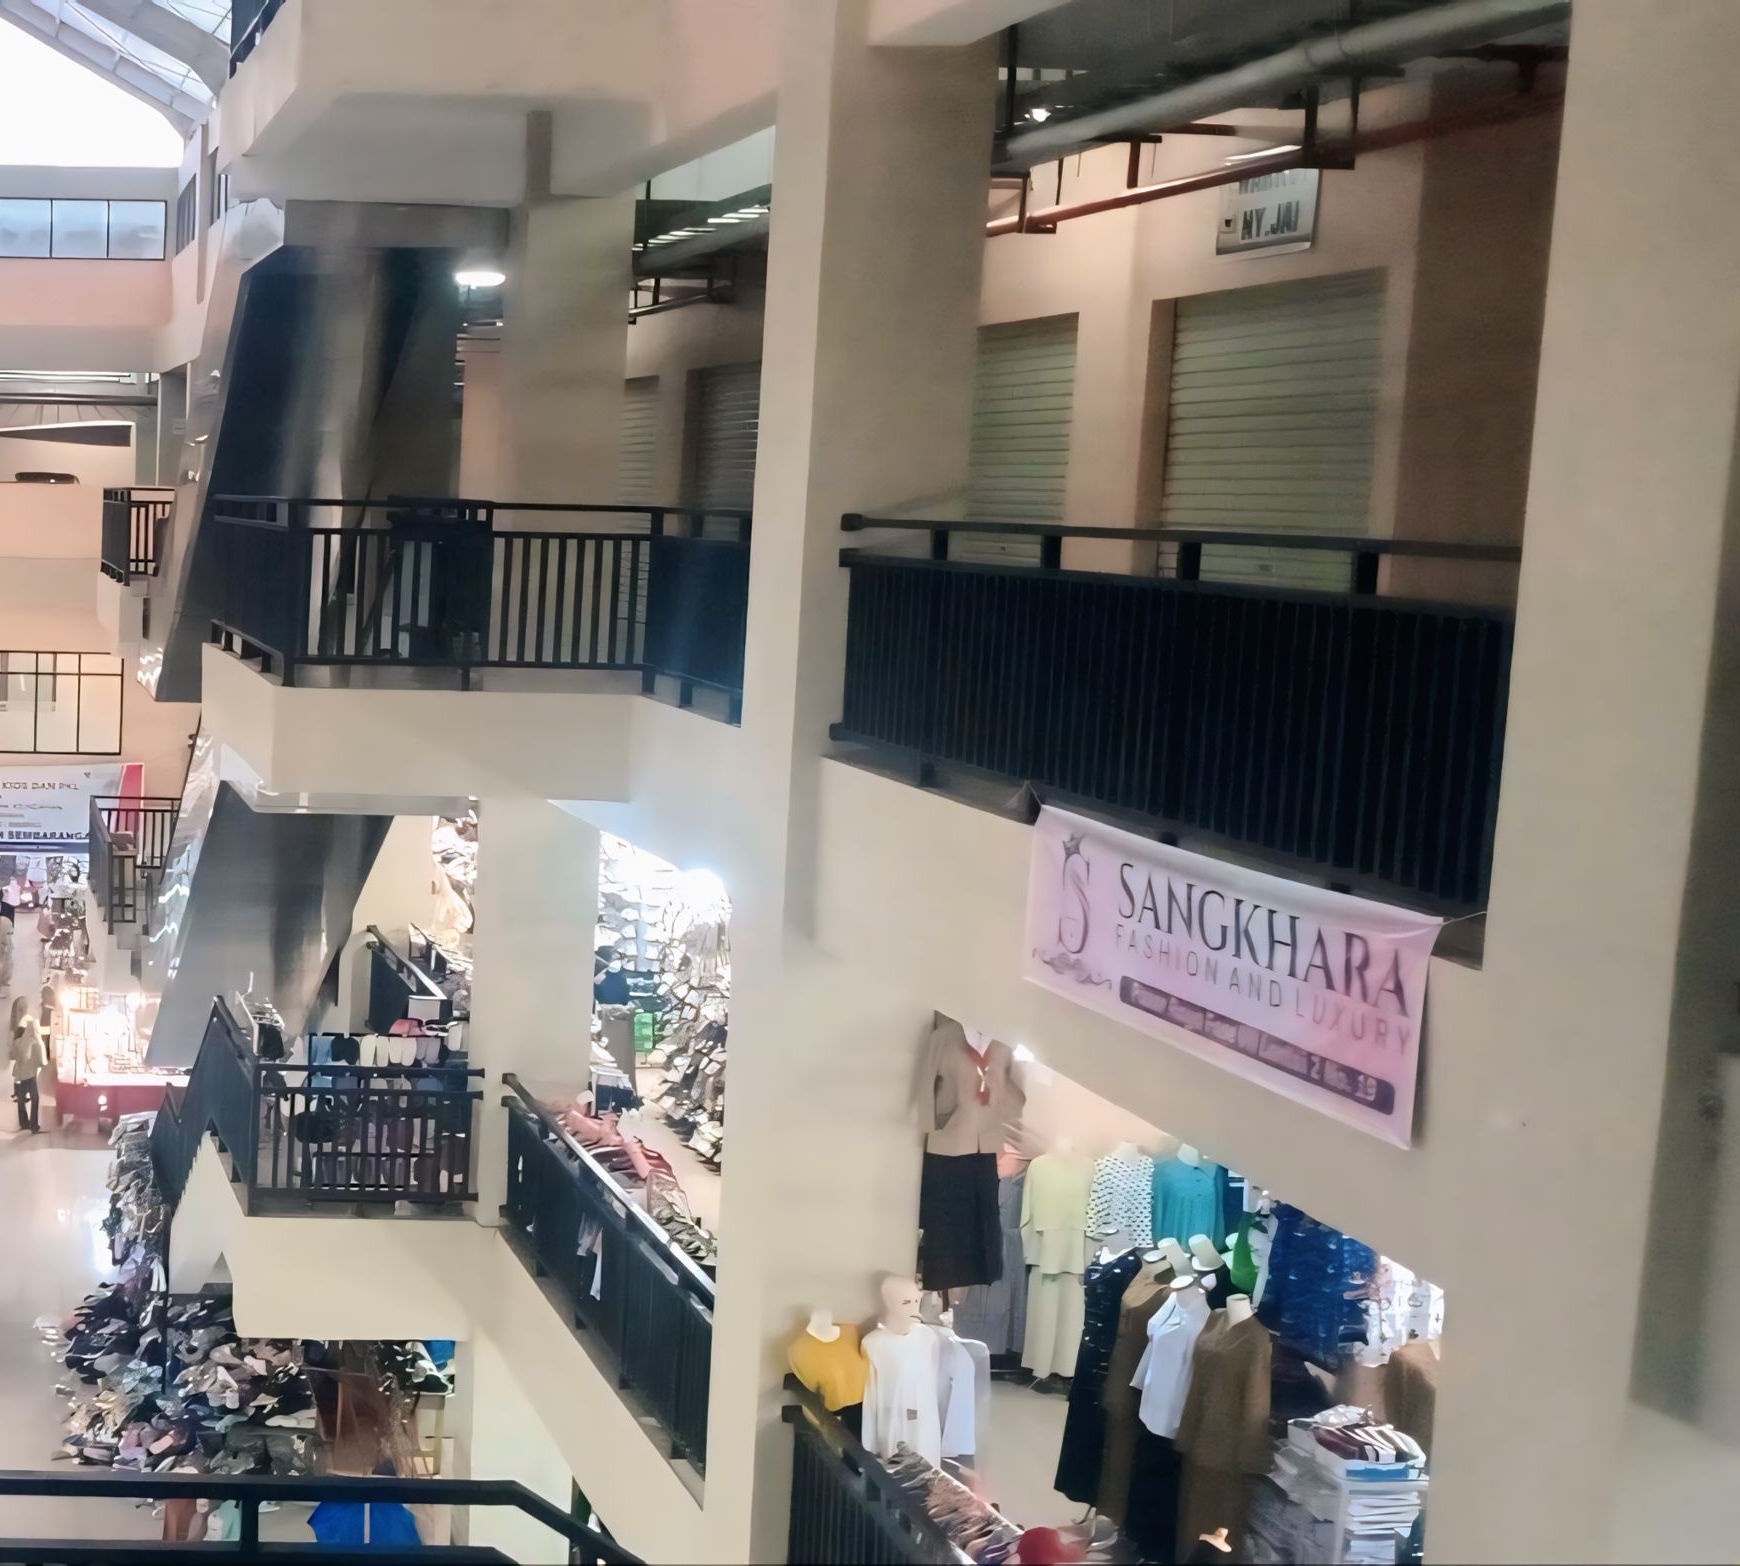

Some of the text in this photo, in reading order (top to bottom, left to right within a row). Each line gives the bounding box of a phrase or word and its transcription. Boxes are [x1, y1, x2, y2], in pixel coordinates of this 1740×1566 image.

[31, 780, 56, 791] DAN
[1115, 923, 1219, 986] FASHION
[1229, 971, 1282, 1008] AND
[1295, 989, 1412, 1057] LUXURY
[1118, 862, 1410, 1018] SANGKHARA
